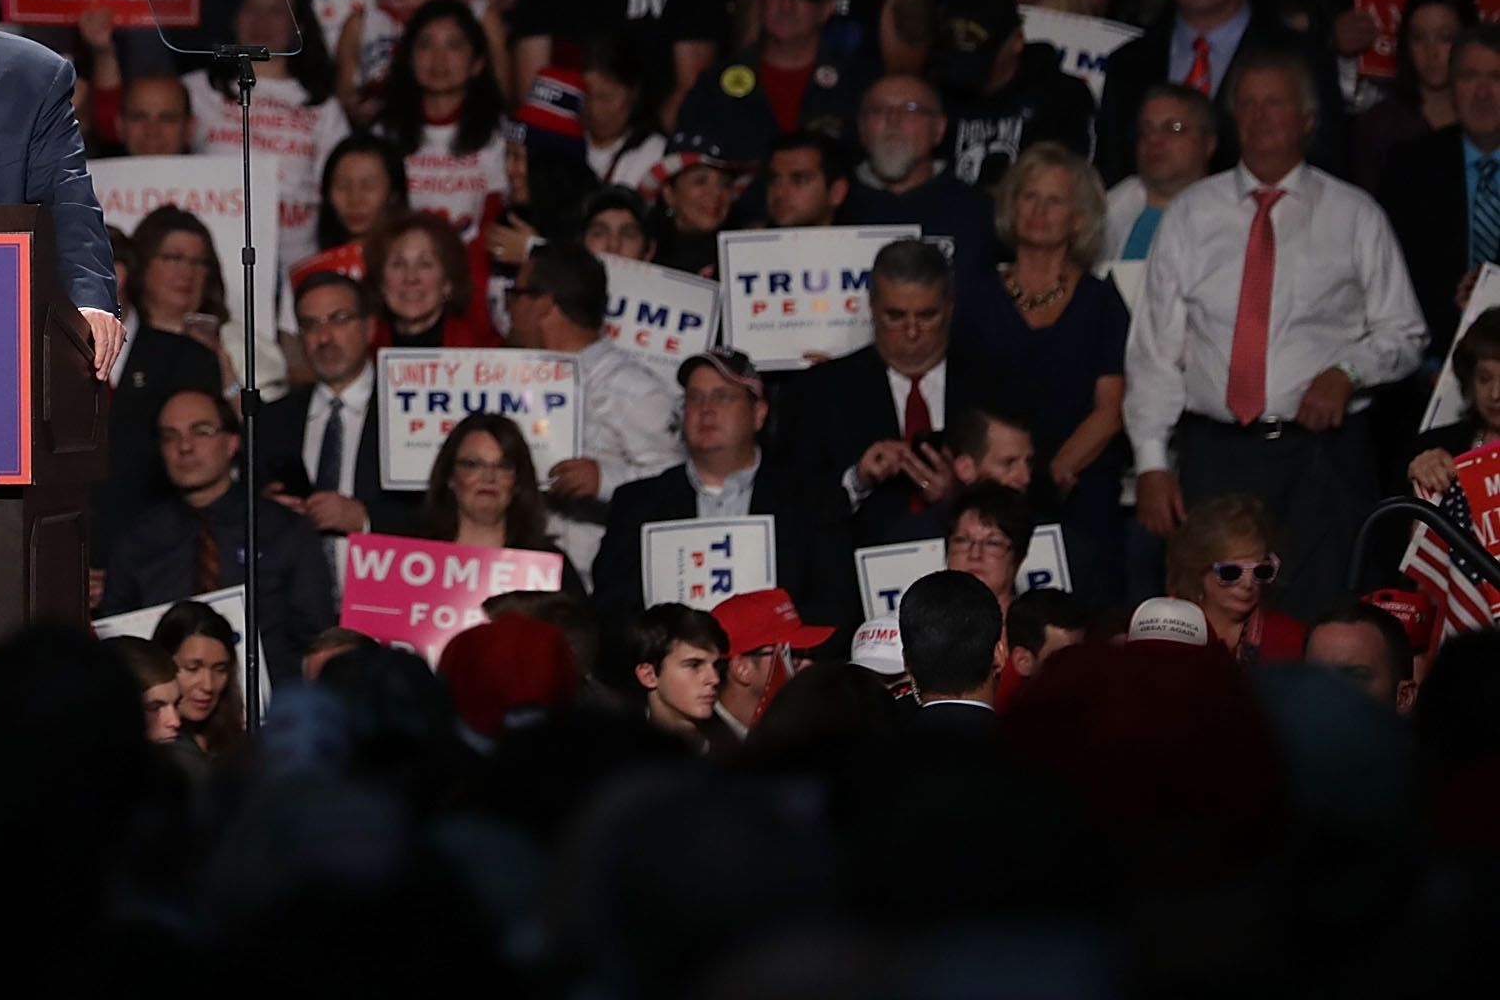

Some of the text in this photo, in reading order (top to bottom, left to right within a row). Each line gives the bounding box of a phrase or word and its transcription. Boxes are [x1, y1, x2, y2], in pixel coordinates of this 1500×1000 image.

[100, 187, 244, 217] ALDEANS
[738, 269, 871, 294] TRUM
[605, 297, 704, 333] UMP
[605, 324, 682, 352] NCE
[388, 361, 461, 387] UNITY
[396, 391, 566, 416] TRUMP
[349, 545, 559, 594] WOMEN
[409, 601, 488, 629] FOR
[1163, 617, 1199, 633] AMERICA
[856, 628, 899, 642] TRUMP
[1169, 626, 1196, 637] AGAIN
